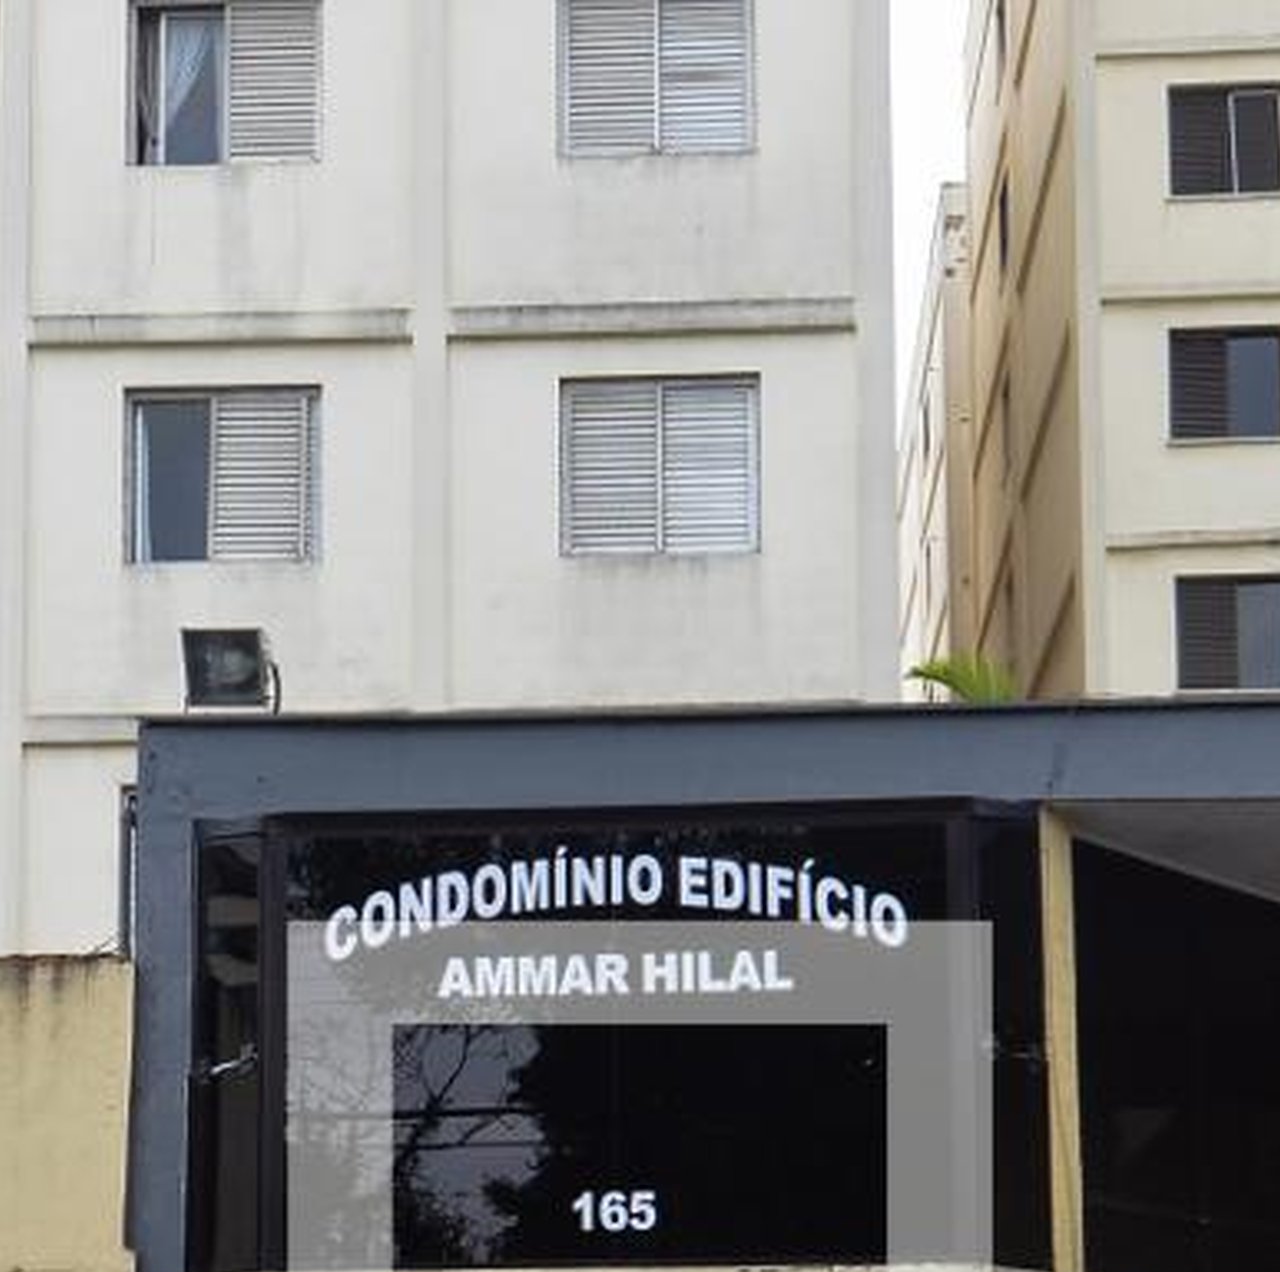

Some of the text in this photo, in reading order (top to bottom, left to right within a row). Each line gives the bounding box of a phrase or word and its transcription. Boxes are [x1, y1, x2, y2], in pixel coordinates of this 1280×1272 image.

[324, 847, 908, 960] CONDOMÍNIO EDIFÍCIO
[437, 950, 793, 998] AMMAR HILAL
[571, 1191, 656, 1231] 165
